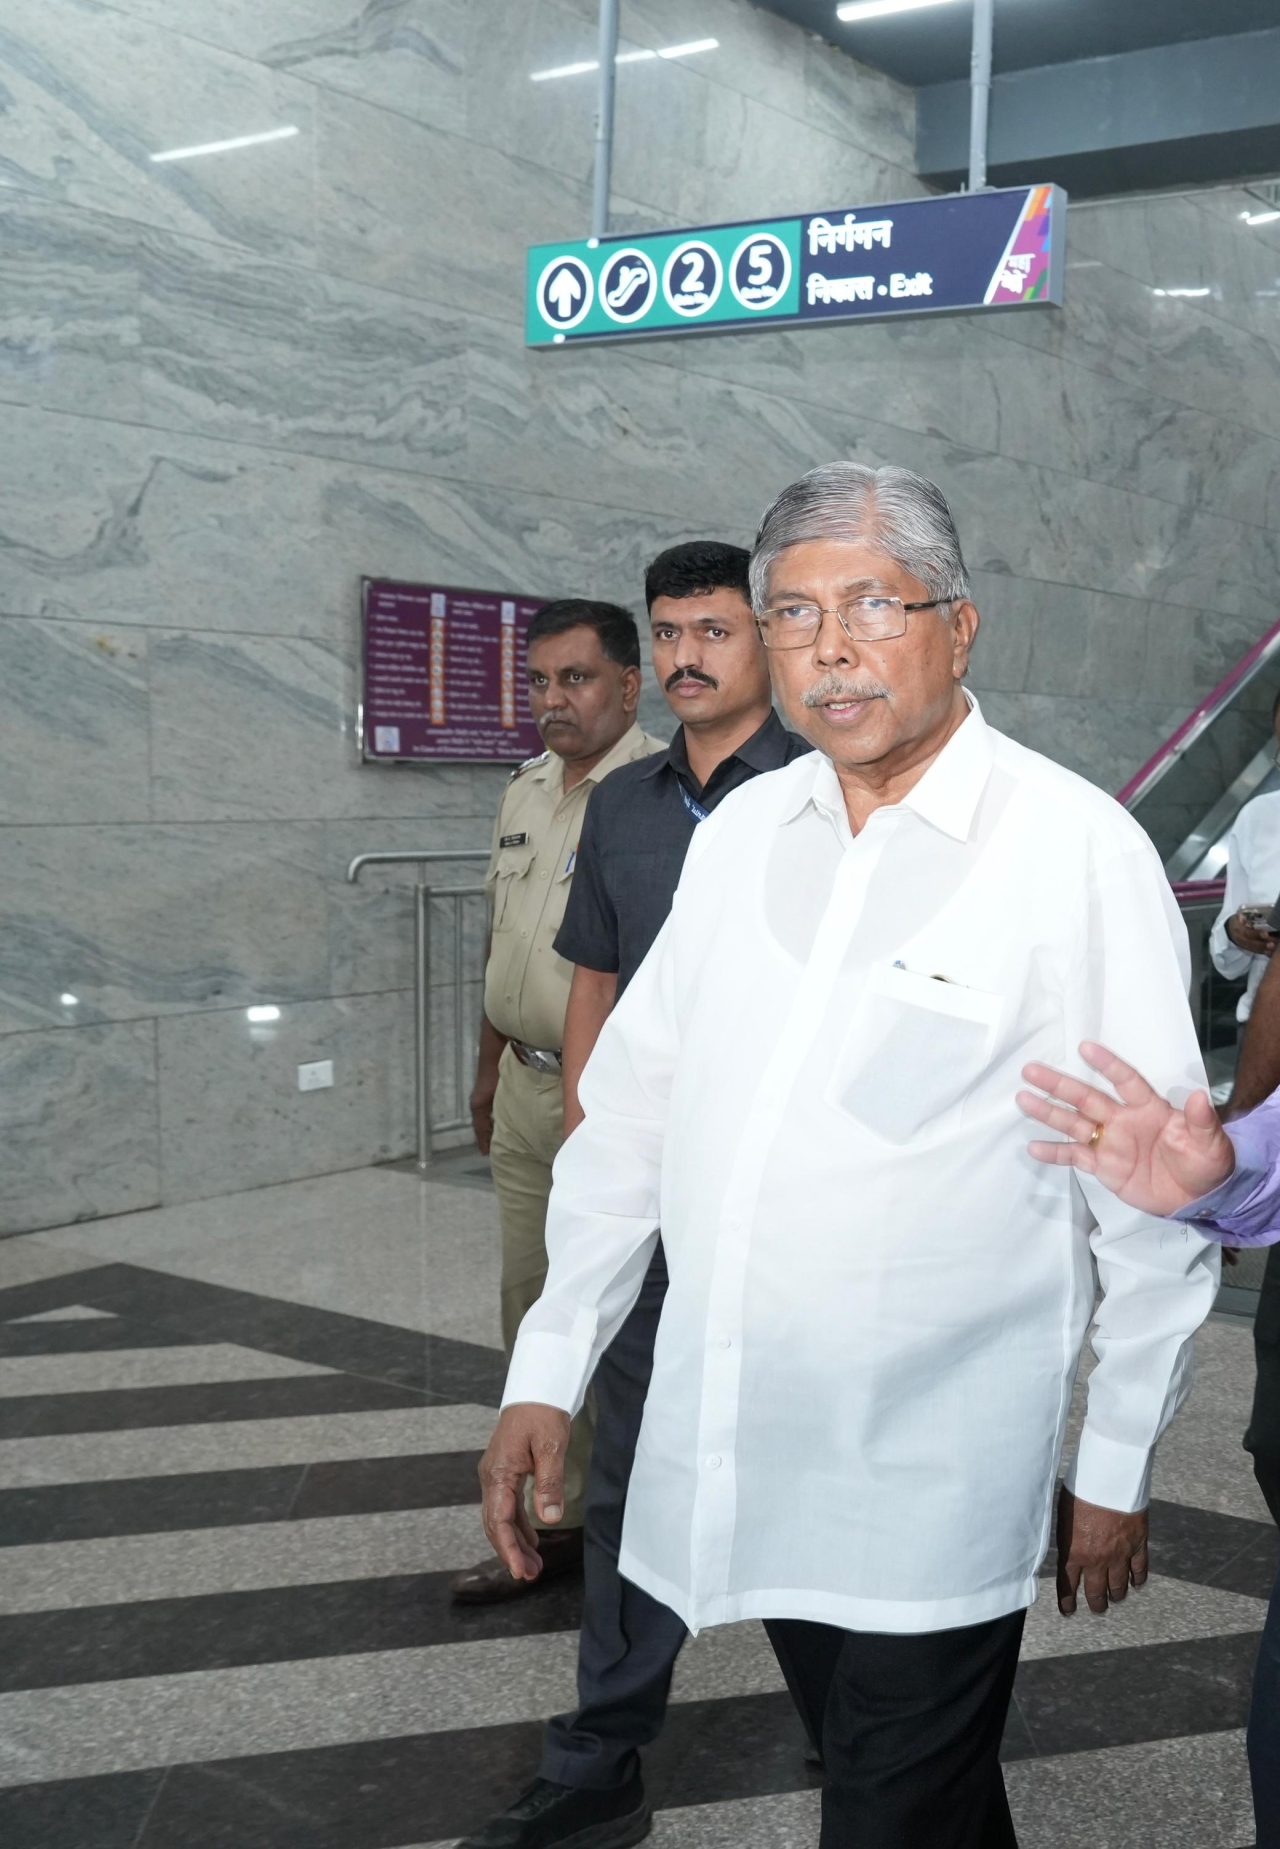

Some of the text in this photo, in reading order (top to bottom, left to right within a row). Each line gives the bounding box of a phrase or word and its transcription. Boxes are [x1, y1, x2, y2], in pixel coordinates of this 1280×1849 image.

[807, 213, 893, 255] निर्गमन
[681, 251, 705, 292] 2
[747, 244, 773, 286] 5
[890, 272, 933, 298] Exit
[806, 272, 876, 305] निकास
